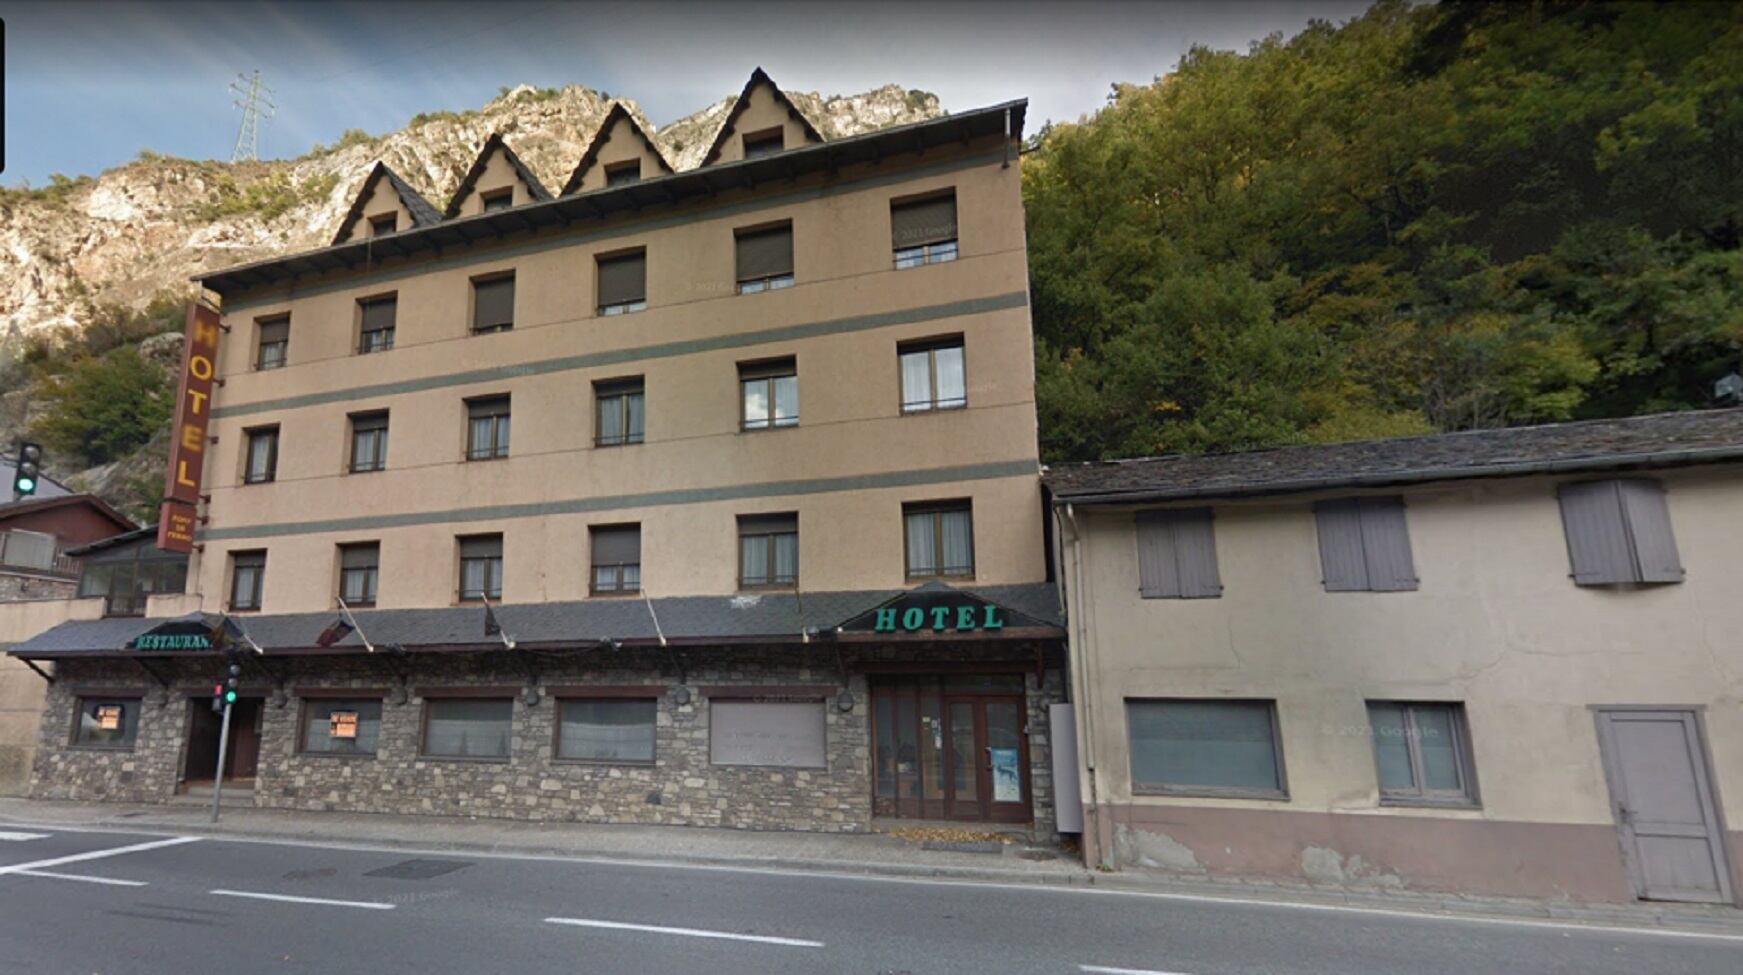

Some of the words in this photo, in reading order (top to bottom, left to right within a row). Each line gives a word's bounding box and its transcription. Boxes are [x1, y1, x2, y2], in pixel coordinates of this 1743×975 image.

[178, 320, 217, 487] HOTEL
[874, 605, 1003, 631] HOTEL
[136, 634, 213, 649] RESTAURAN
